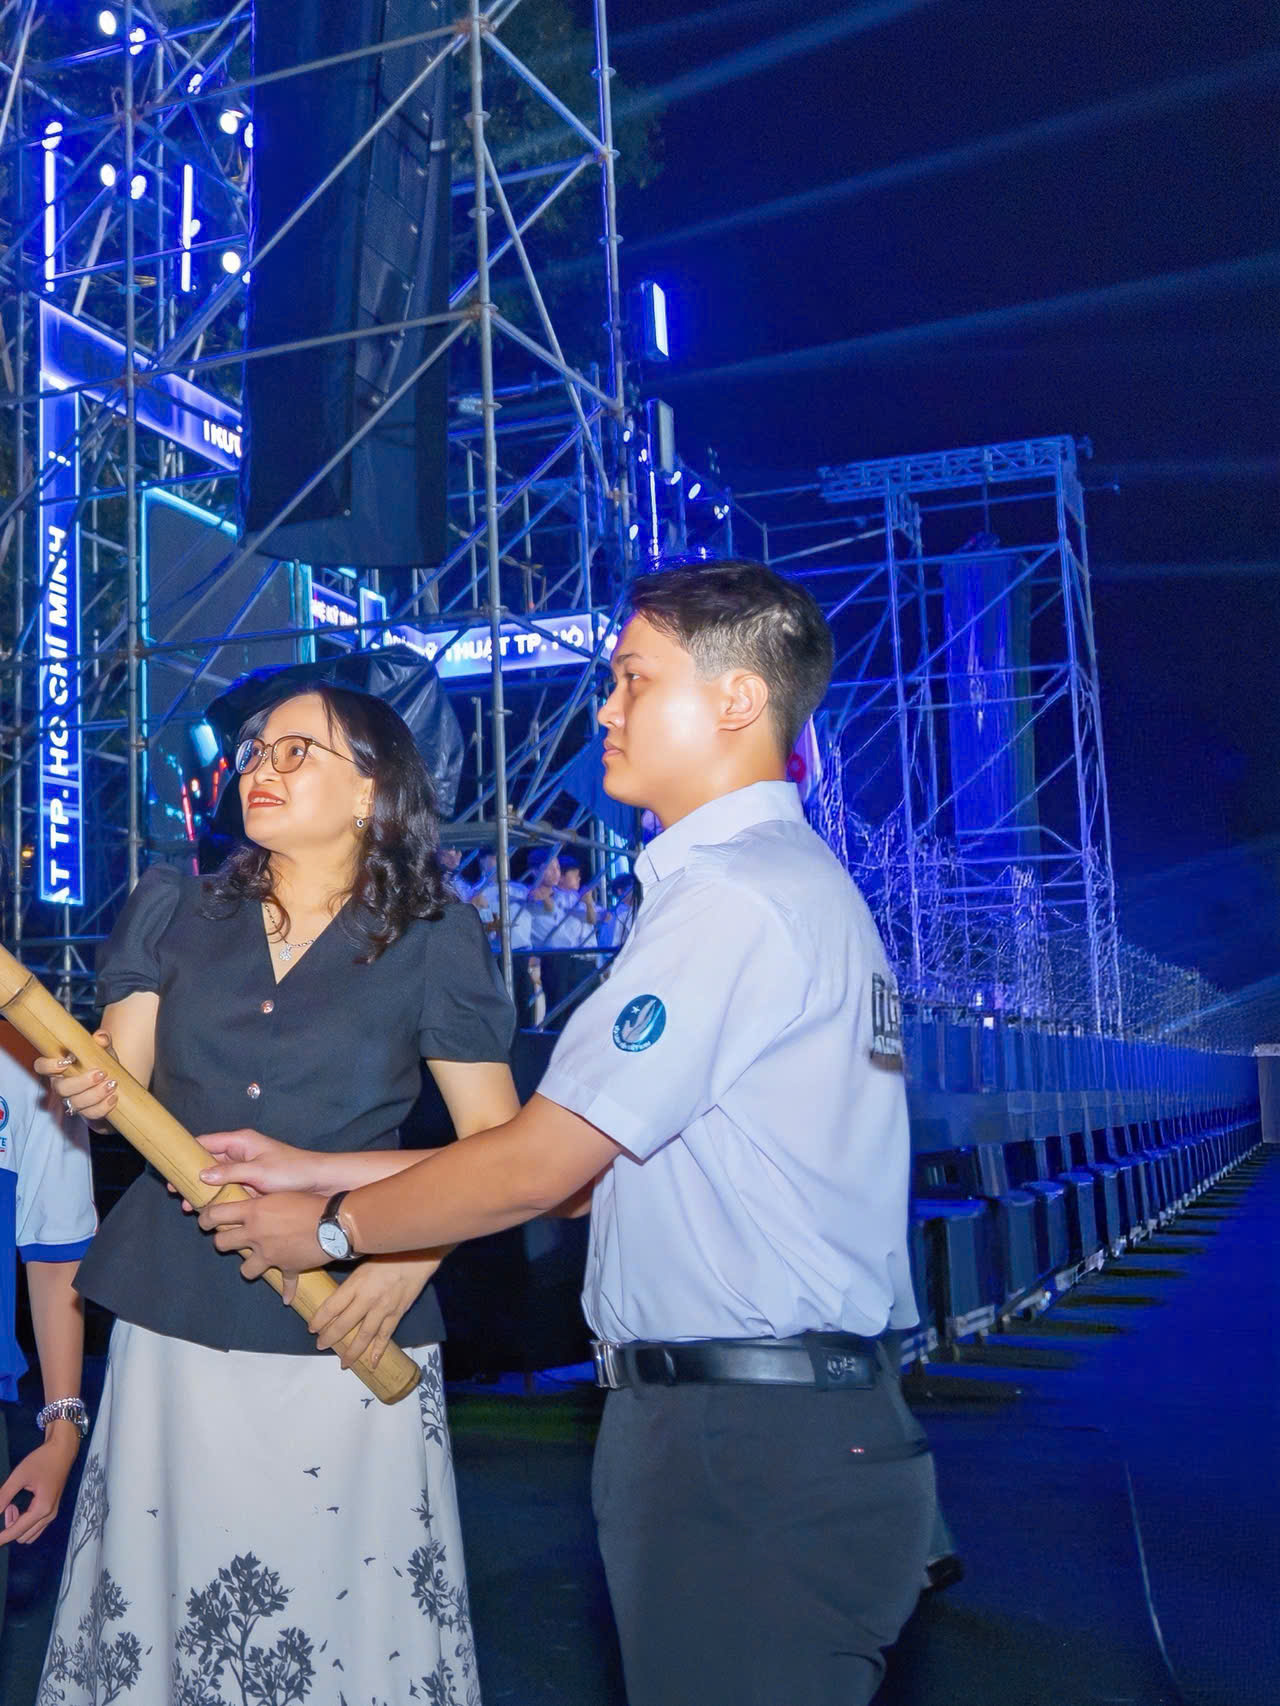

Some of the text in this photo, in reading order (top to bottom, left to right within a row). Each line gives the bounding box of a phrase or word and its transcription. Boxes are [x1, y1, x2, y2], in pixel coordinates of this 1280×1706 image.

[48, 525, 68, 628] MINH
[513, 632, 547, 654] TP.
[49, 789, 70, 850] TP.
